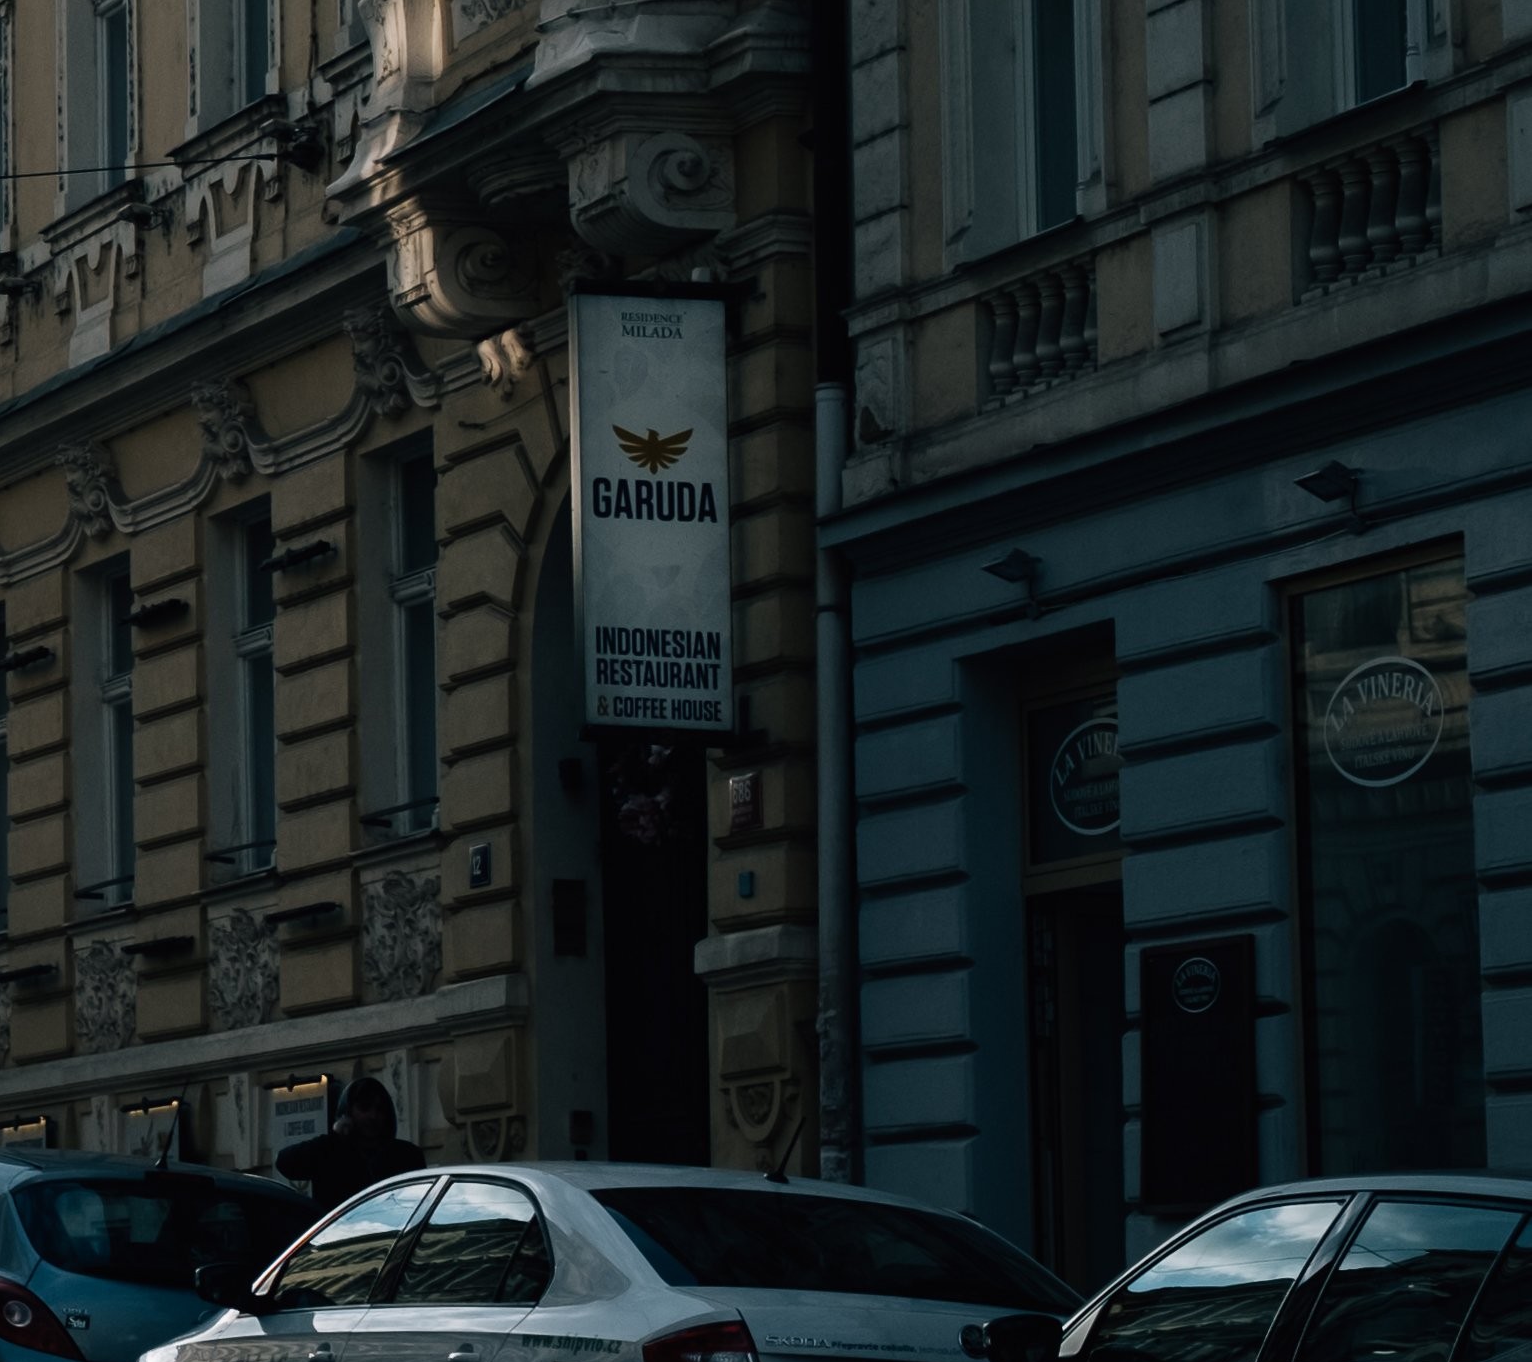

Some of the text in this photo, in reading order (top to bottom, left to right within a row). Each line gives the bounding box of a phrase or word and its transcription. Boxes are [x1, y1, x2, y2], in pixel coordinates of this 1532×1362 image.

[621, 311, 683, 324] RESIDENCE
[621, 325, 683, 339] MILADA
[592, 477, 717, 523] GARUDA
[596, 626, 721, 660] INDONESIAN
[596, 658, 721, 690] RESTAURANT
[597, 695, 722, 722] & COFFEE HOUSE
[1330, 672, 1434, 732] LA VINERIA
